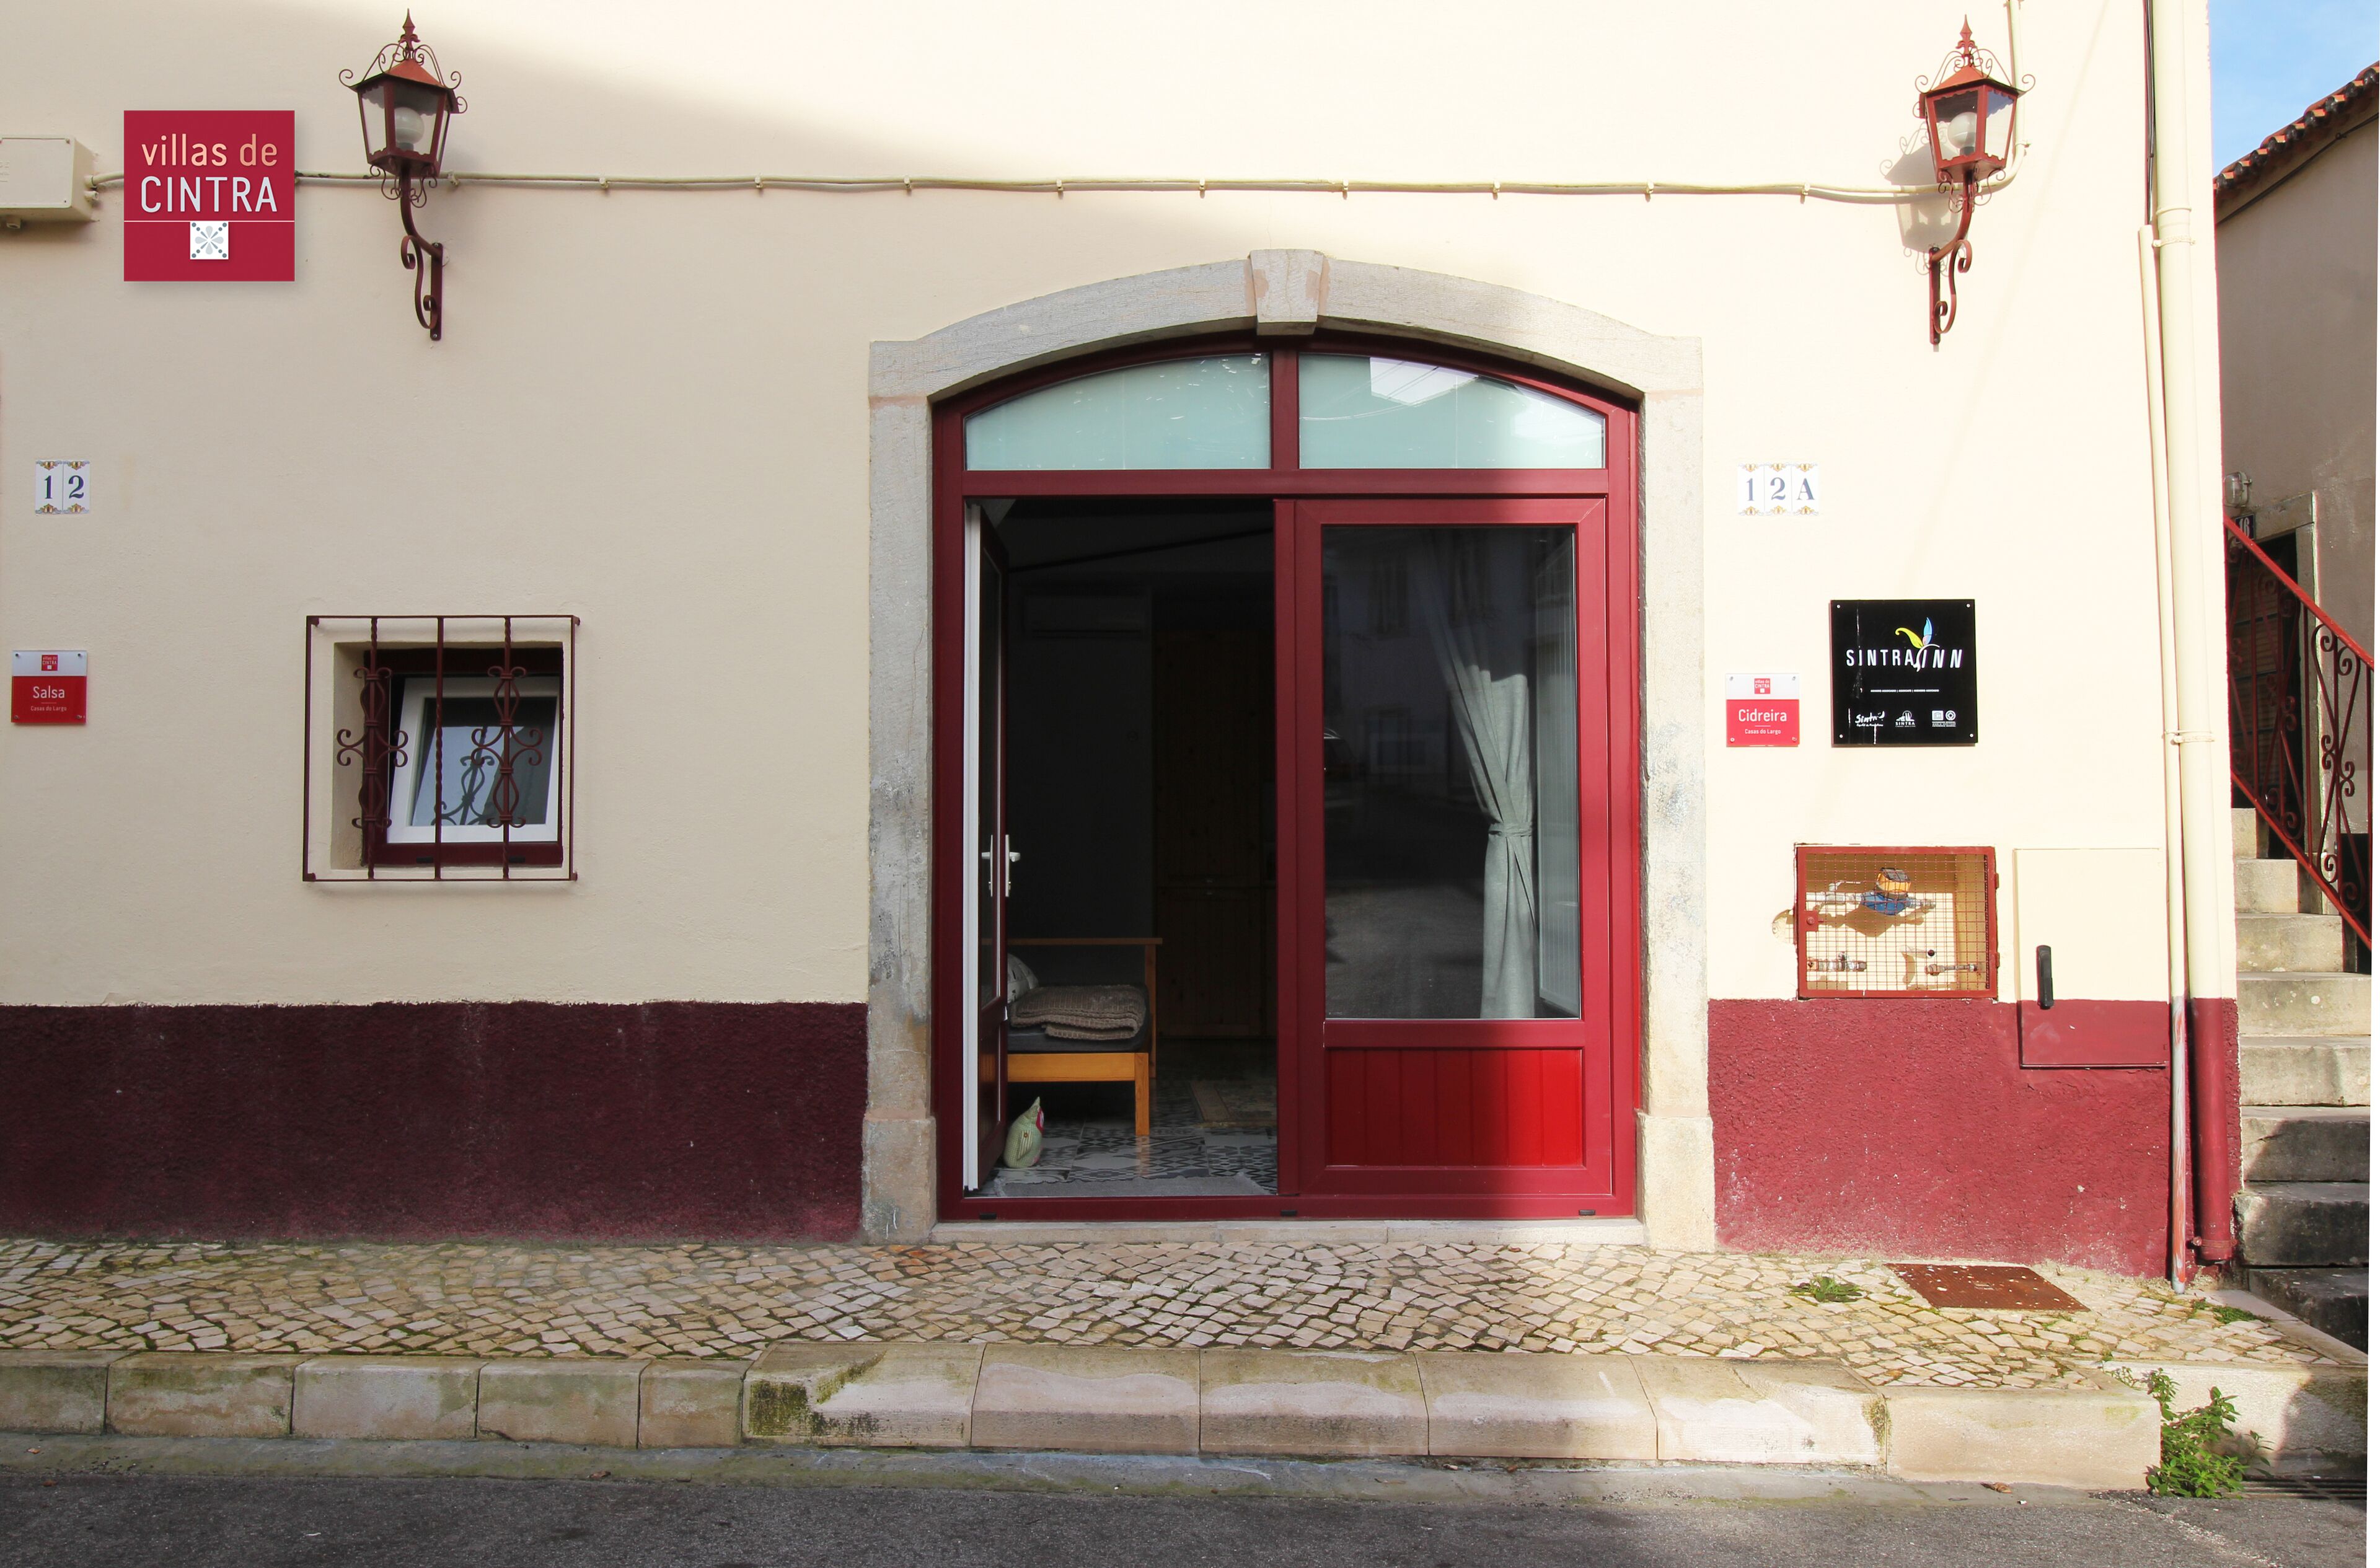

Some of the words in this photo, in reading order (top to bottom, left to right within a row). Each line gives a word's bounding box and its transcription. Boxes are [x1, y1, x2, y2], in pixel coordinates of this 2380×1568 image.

[44, 475, 84, 500] 12
[1746, 477, 1815, 501] 12A
[1846, 649, 1914, 666] SINTRA
[1921, 648, 1963, 669] INN
[33, 685, 64, 698] Salsa
[1739, 708, 1787, 721] Cidreira
